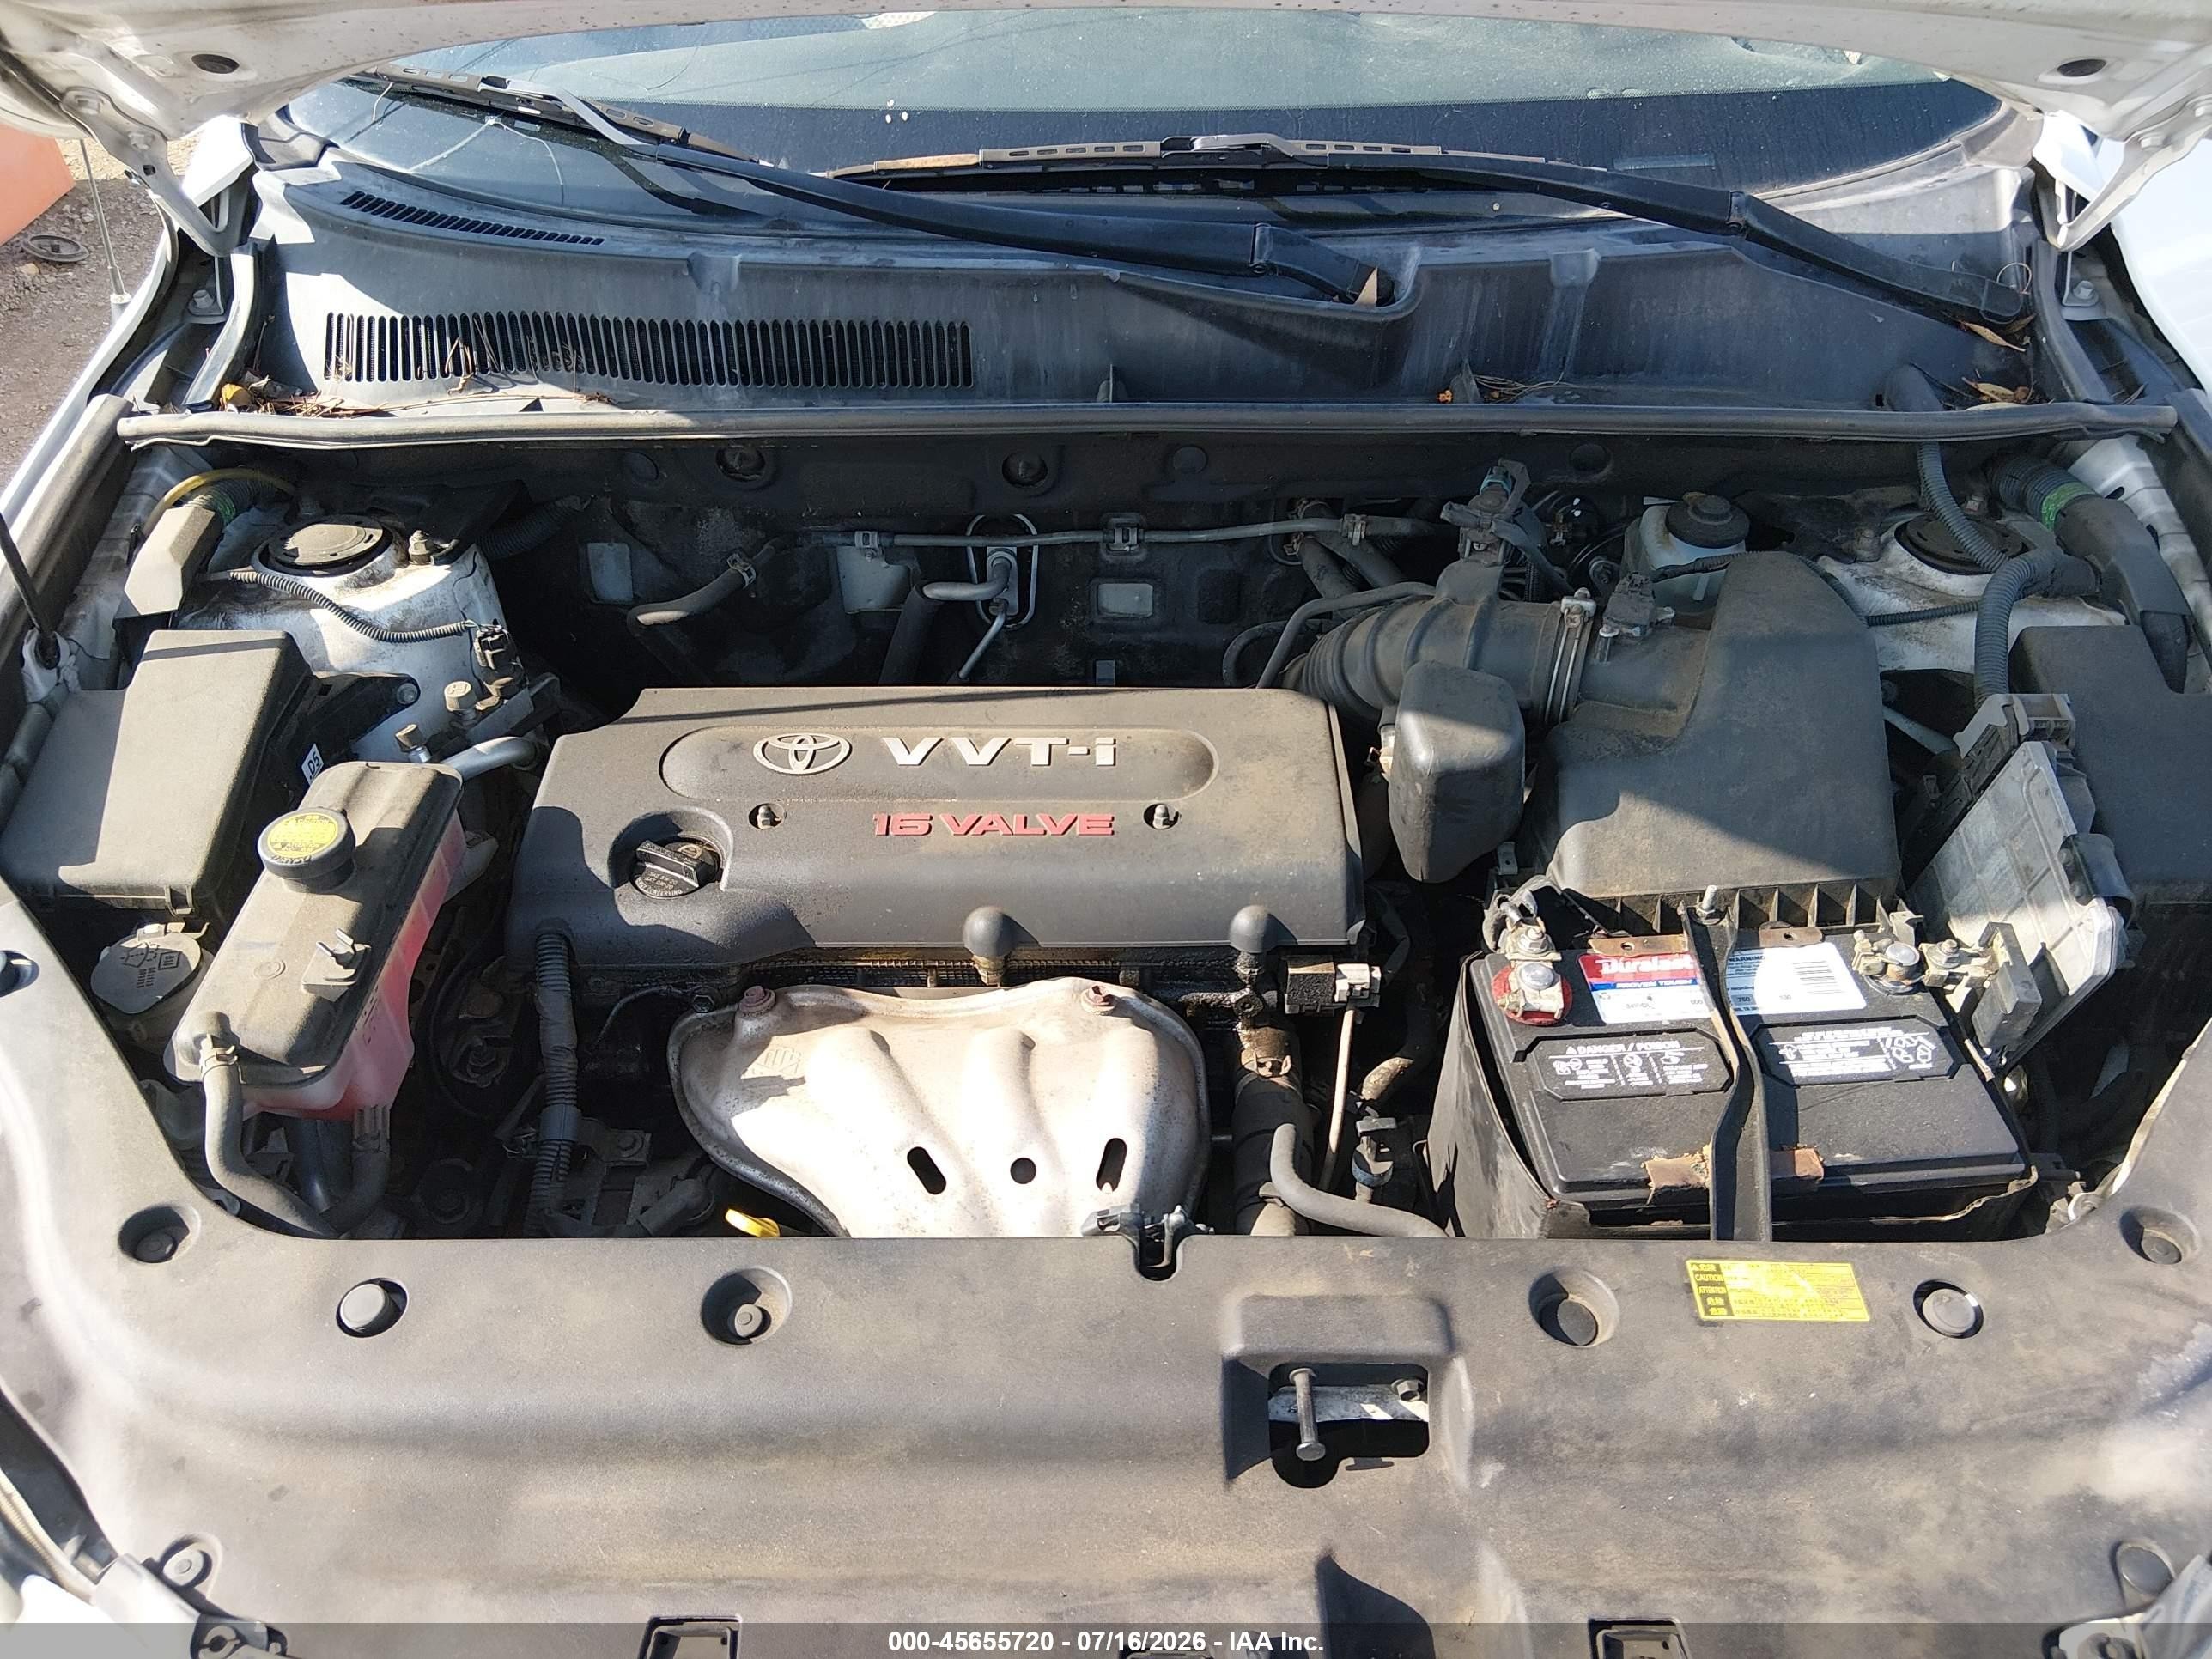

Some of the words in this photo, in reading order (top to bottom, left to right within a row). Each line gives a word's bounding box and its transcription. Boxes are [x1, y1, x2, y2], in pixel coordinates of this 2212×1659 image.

[882, 737, 1116, 767] VVT-i
[872, 812, 933, 836] 16
[939, 812, 1115, 836] VALVE
[1595, 953, 1695, 975] Duralast
[1615, 981, 1657, 989] PROVEN
[1577, 1043, 1626, 1054] DANGER
[1637, 1040, 1680, 1051] POISON
[1694, 1273, 1725, 1282] CAUTION
[1698, 1285, 1728, 1294] ATTENTION
